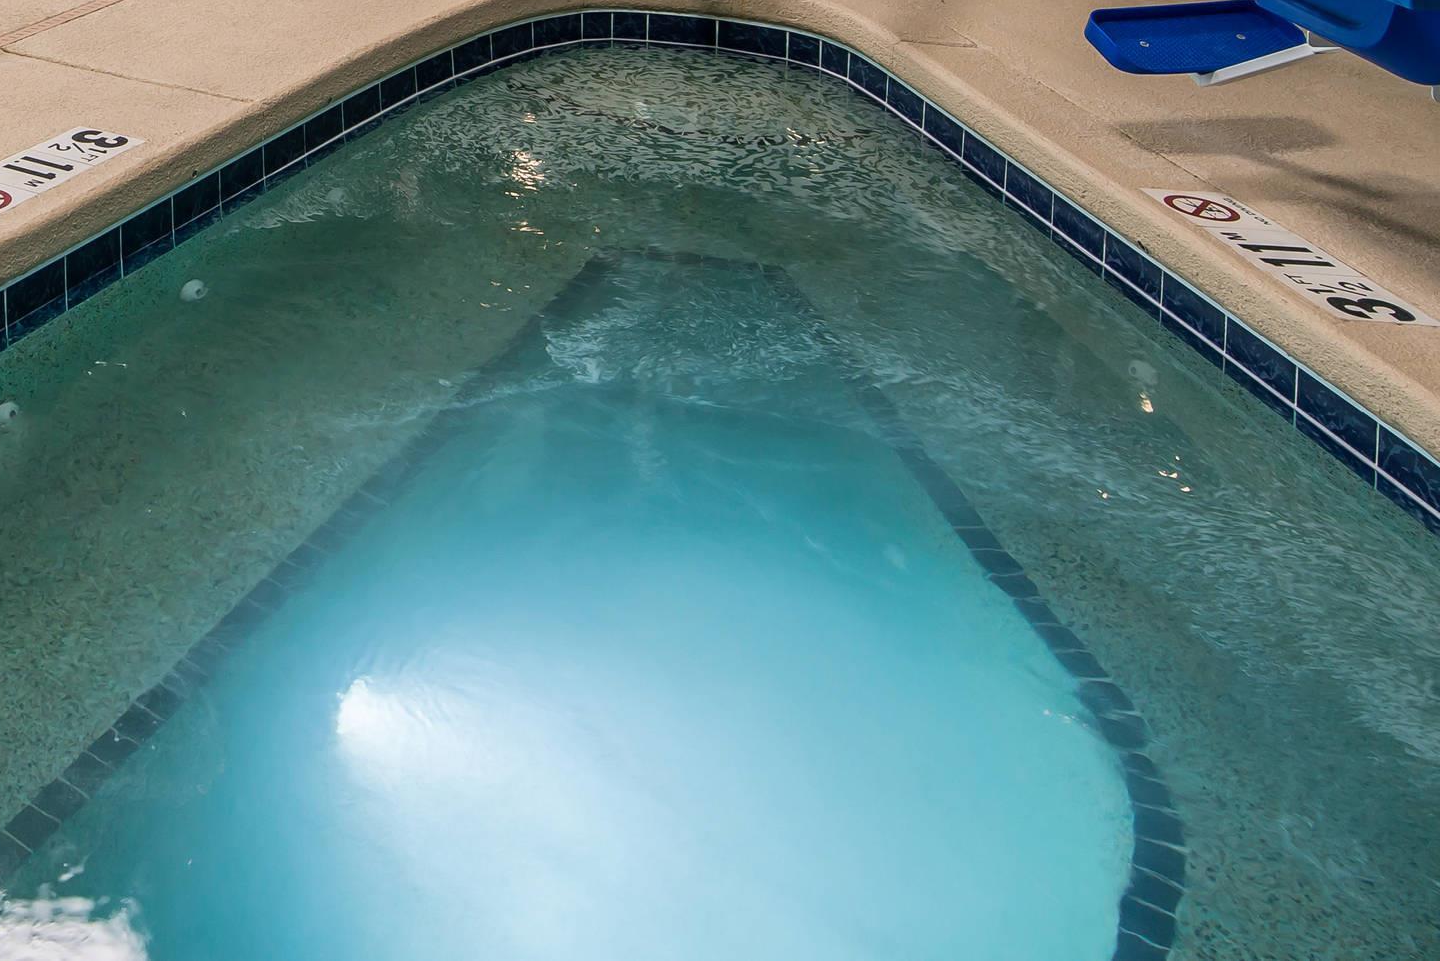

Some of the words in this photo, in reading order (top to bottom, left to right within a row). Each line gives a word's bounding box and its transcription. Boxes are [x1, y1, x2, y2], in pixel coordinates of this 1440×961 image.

[71, 130, 129, 148] 3
[80, 153, 99, 162] FT
[3, 156, 73, 180] 1.1
[24, 178, 45, 188] M
[1220, 231, 1247, 242] M
[1237, 243, 1337, 268] 1.1
[1283, 272, 1316, 285] FT
[1326, 296, 1417, 322] 3
